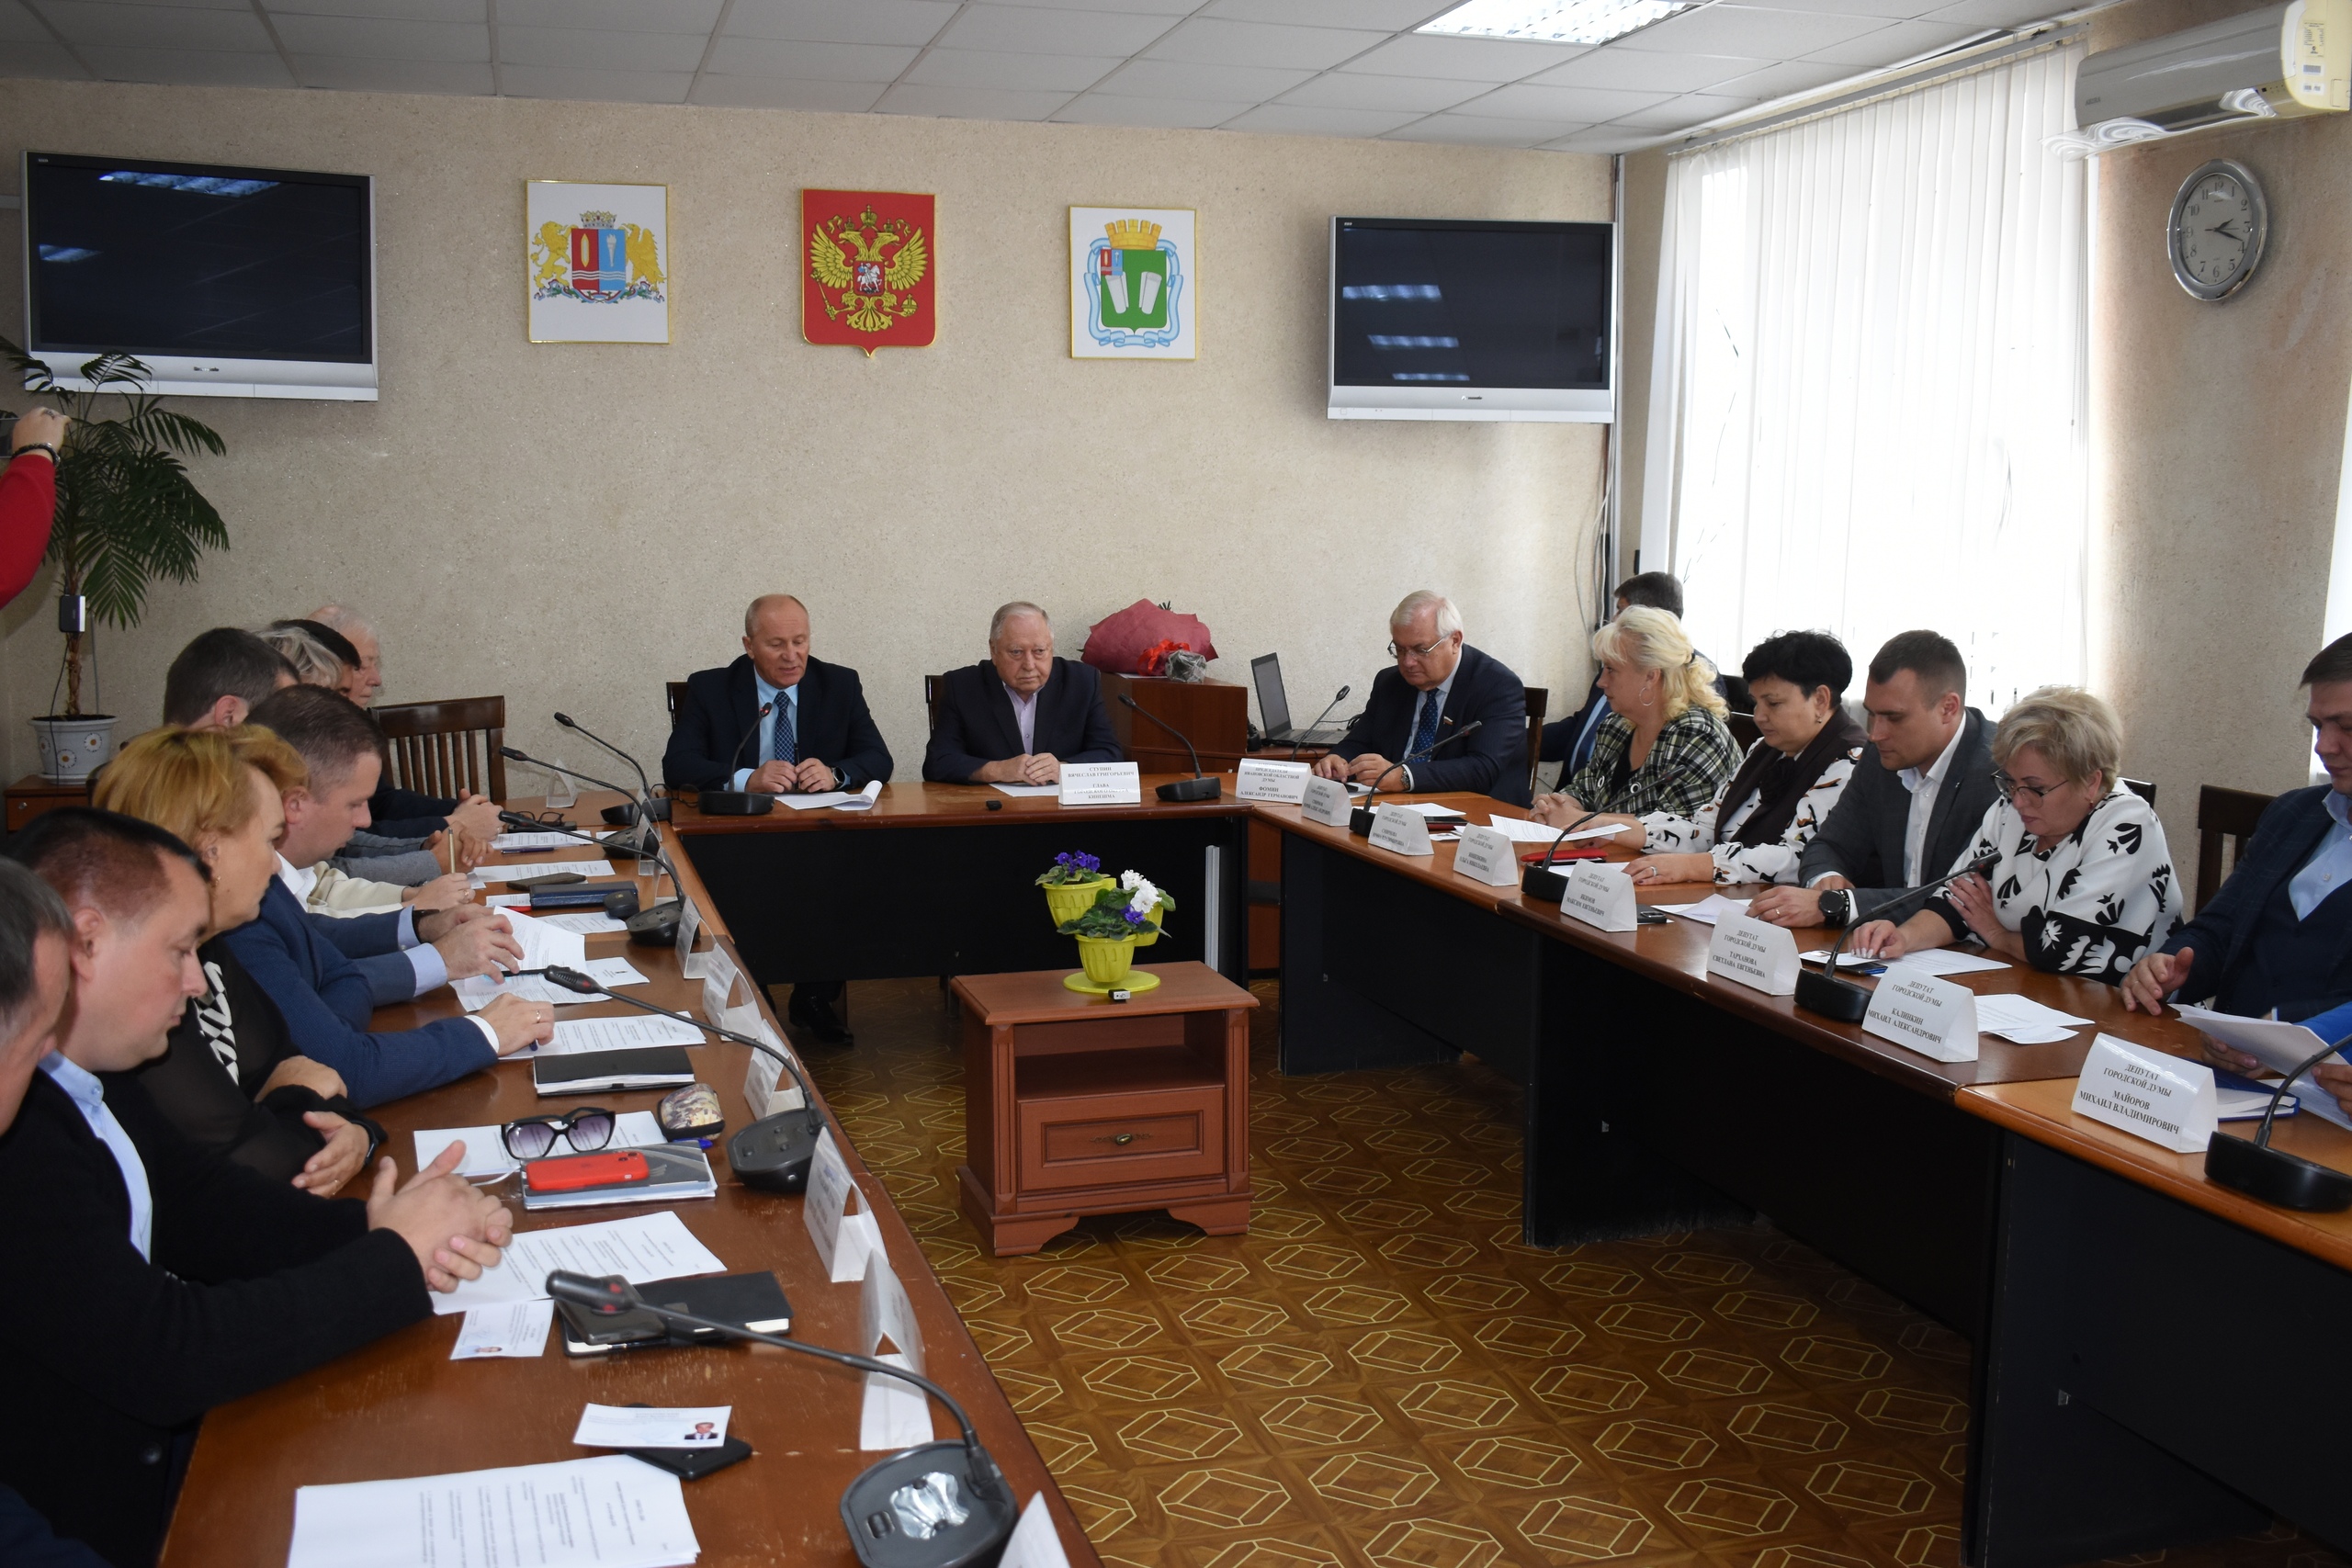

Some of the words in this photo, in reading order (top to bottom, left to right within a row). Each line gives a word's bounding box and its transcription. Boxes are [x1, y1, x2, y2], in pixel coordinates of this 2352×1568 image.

[2201, 189, 2209, 200] 11
[2190, 205, 2200, 216] 10
[2241, 199, 2247, 211] 2
[2186, 227, 2193, 238] 9
[2243, 221, 2250, 233] 3
[2190, 245, 2197, 257] 8
[2238, 241, 2246, 254] 4
[2200, 261, 2206, 273] 7
[2228, 259, 2235, 271] 5
[2213, 266, 2220, 278] 6
[1737, 930, 1759, 941] ДЕПУТАТ
[1724, 934, 1751, 948] ГОРОДСКОЙ
[1751, 943, 1766, 953] ДУМЫ
[1729, 951, 1757, 966] ТАРХАНОВА
[1712, 955, 1735, 968] СВЕТЛАНА
[1737, 963, 1766, 978] ЕВГЕНЬЕВНА
[1908, 980, 1934, 993] ДЕПУТАТ
[1892, 984, 1925, 1001] ГОРОДСКОЙ
[1923, 995, 1943, 1007] ДУМЫ
[1891, 1008, 1924, 1025] КАЛИНКИН
[1868, 1009, 1891, 1024] МИХАИЛ
[1893, 1021, 1942, 1043] АЛЕКСАНДРОВИЧ
[2125, 1063, 2160, 1081] ДЕПУТАТ
[2103, 1067, 2147, 1088] ГОРОДСКОЙ
[2147, 1083, 2172, 1097] ДУМЫ
[2112, 1090, 2151, 1110] МАЙОРОВ
[2078, 1091, 2112, 1110] МИХАИЛ
[2112, 1104, 2179, 1134] ВЛАДИМИРОВИЧ
